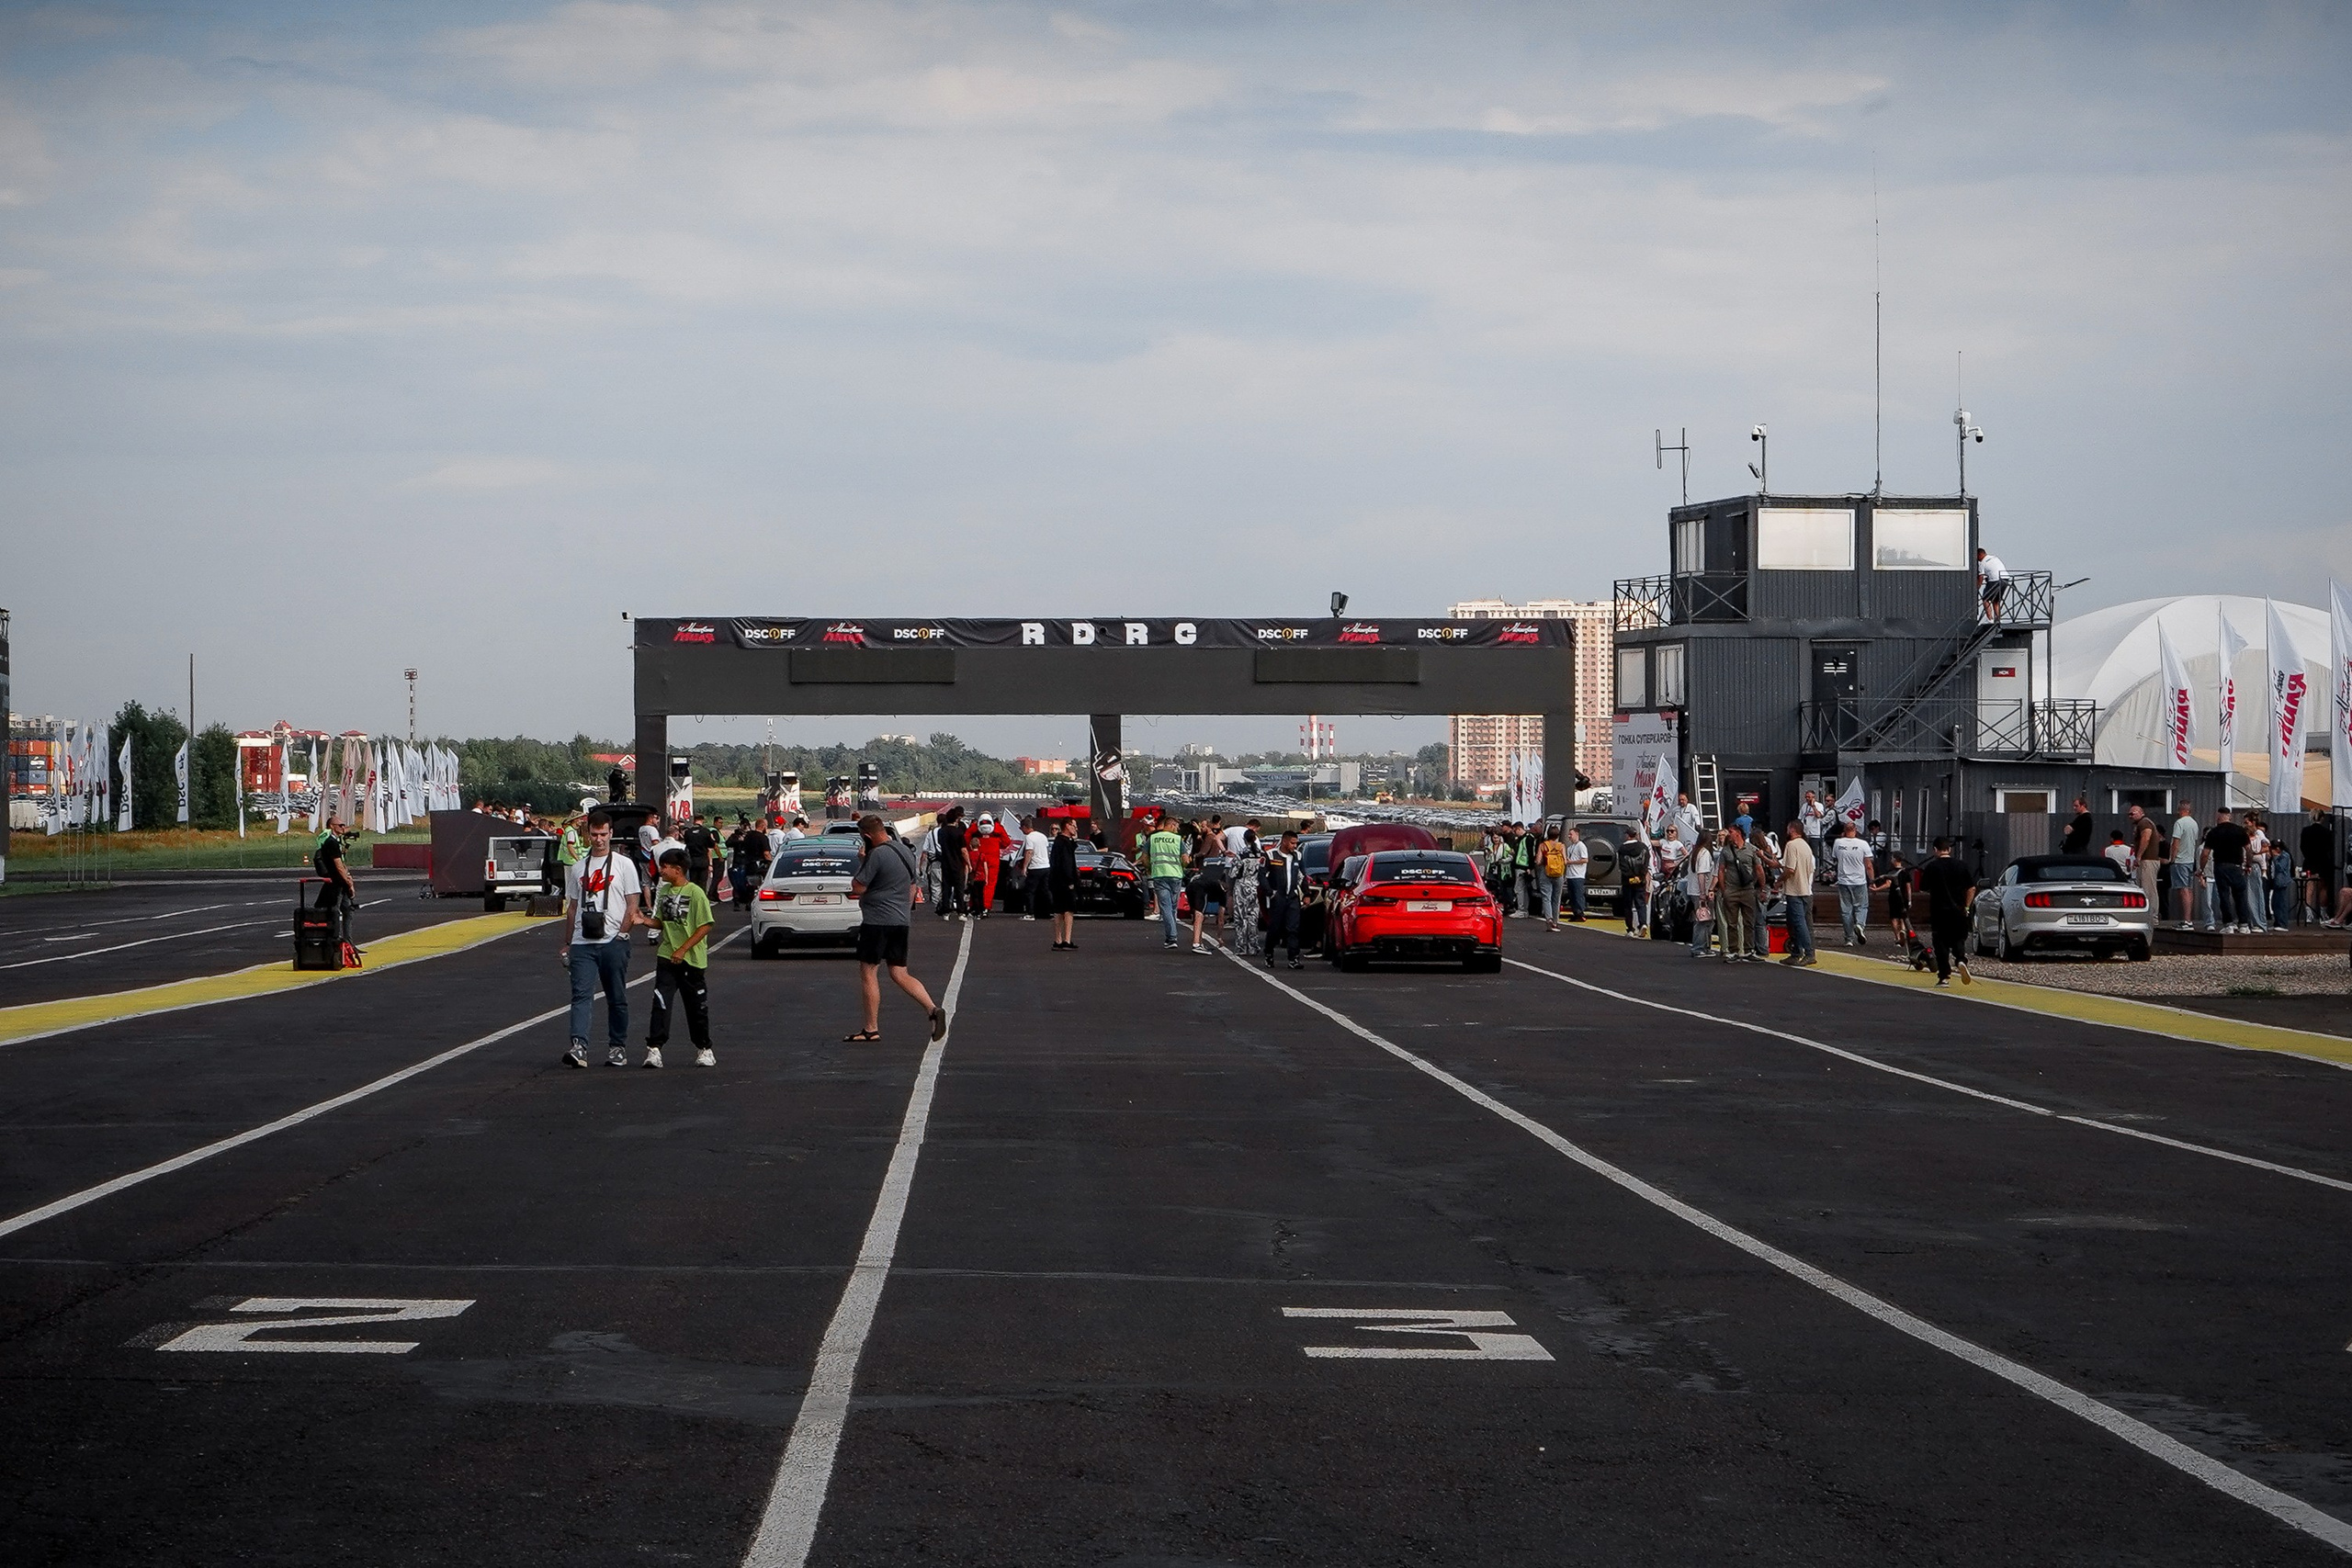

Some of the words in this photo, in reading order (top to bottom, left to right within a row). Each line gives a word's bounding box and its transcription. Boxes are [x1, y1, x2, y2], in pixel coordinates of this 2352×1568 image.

[669, 799, 691, 820] 1/8
[782, 799, 797, 813] 1/4
[155, 1298, 477, 1354] 2
[1282, 1307, 1556, 1360] 3
